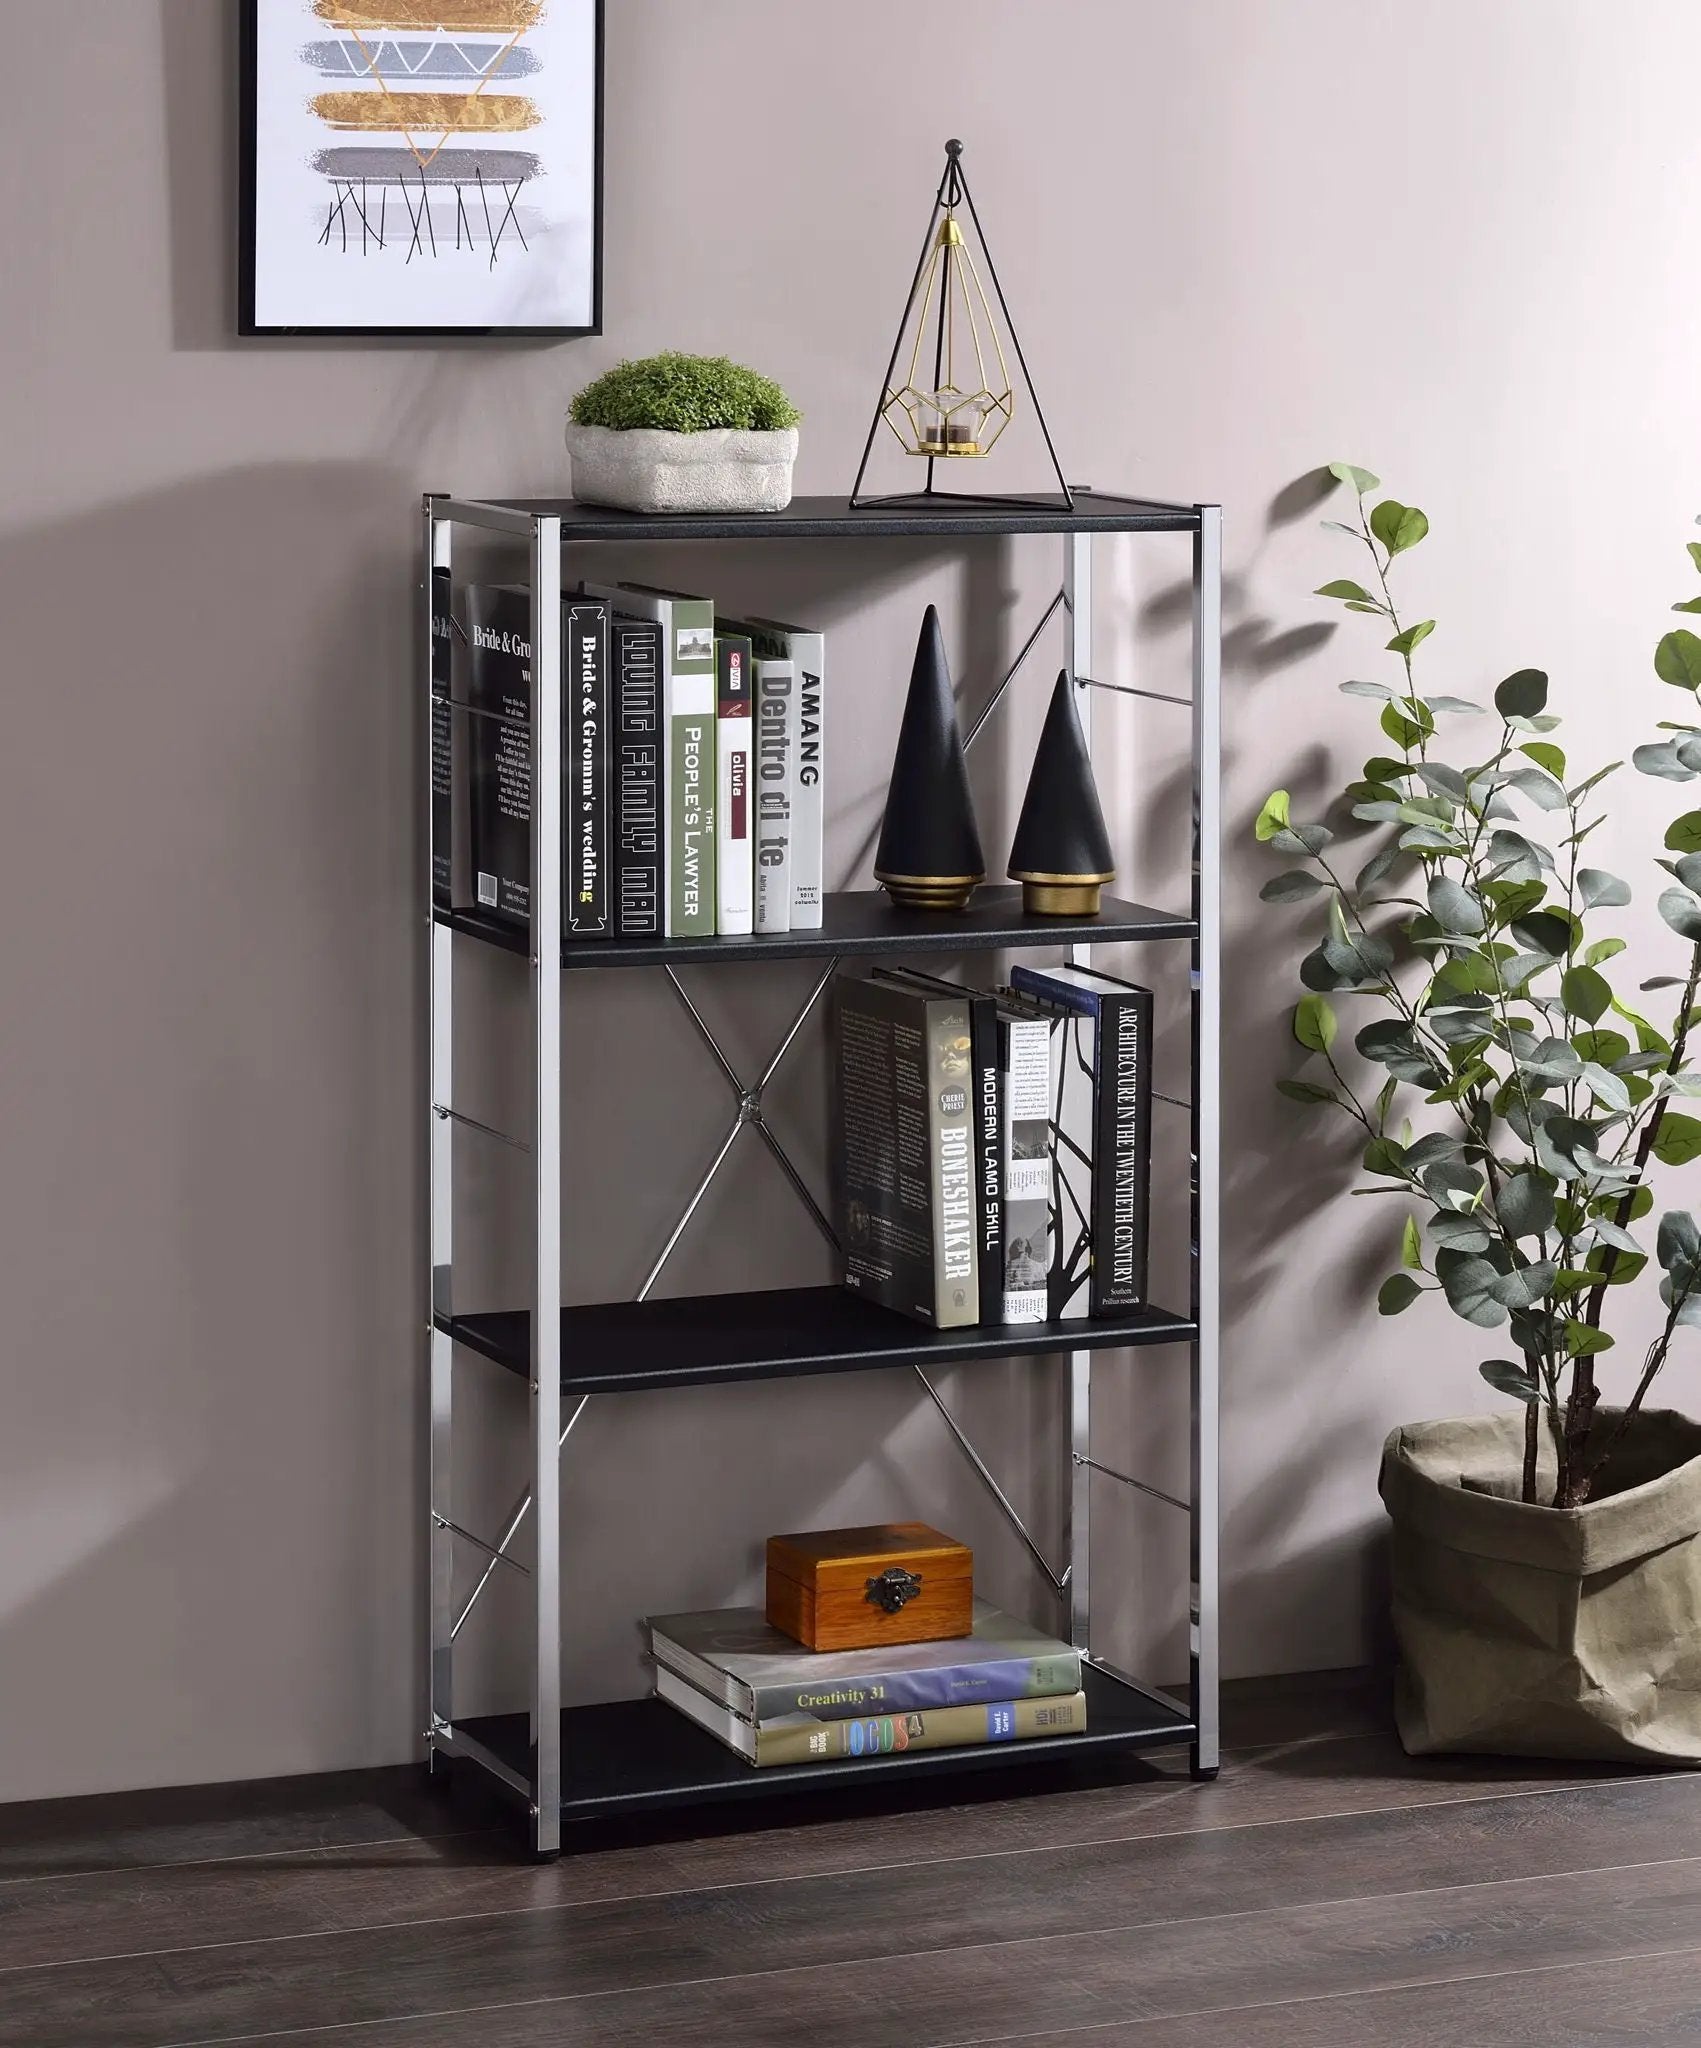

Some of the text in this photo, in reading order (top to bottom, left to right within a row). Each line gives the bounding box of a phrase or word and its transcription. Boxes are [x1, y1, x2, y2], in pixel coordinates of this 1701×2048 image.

[472, 624, 501, 651] Bride
[501, 631, 511, 654] &
[511, 634, 531, 658] Gro
[621, 632, 656, 732] LOVING
[760, 676, 793, 781] Dentro
[800, 671, 821, 787] AMANG
[579, 635, 597, 903] Bride & Gromm's wedding
[732, 755, 745, 797] olivia
[621, 744, 657, 853] FAMILY
[759, 791, 790, 820] di
[705, 807, 714, 834] THE
[758, 836, 789, 867] te
[684, 831, 701, 917] LAWYER
[940, 1093, 966, 1103] CHERIE
[942, 1102, 965, 1112] PRIEST
[1116, 1106, 1137, 1121] IN
[1115, 1122, 1137, 1148] THE
[940, 1127, 972, 1280] BONESHAKER
[1114, 1149, 1136, 1224] TWENTIETH
[985, 1201, 1000, 1251] SKILL
[1113, 1226, 1134, 1284] CENTURY
[797, 1685, 885, 1708] Creativity 31
[994, 1718, 1002, 1734] David
